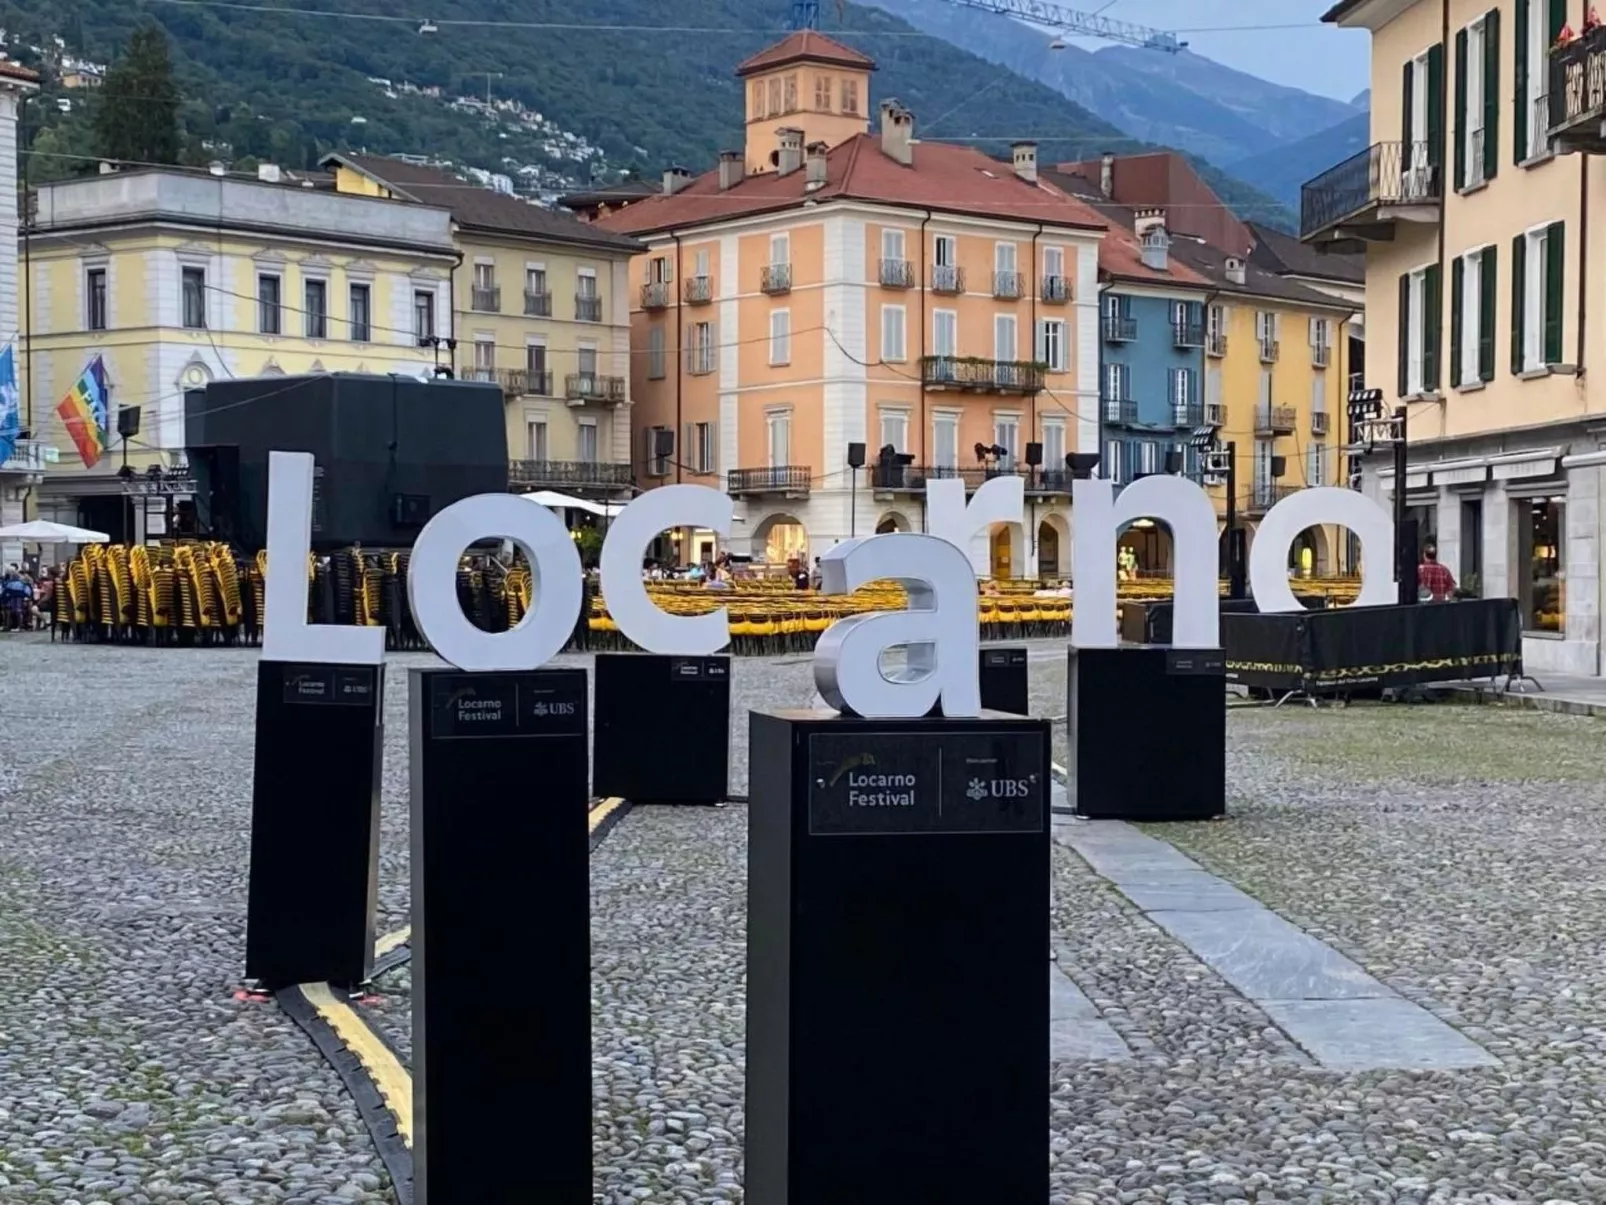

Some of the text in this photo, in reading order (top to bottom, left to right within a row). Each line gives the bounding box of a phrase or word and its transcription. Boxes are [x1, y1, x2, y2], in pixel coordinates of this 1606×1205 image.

[260, 450, 1399, 719] Locarno
[458, 699, 502, 709] Locarno
[550, 703, 574, 715] UBS
[458, 710, 502, 721] Festival
[849, 773, 916, 787] Locarno
[991, 779, 1029, 797] UBS
[849, 790, 915, 806] Festival
